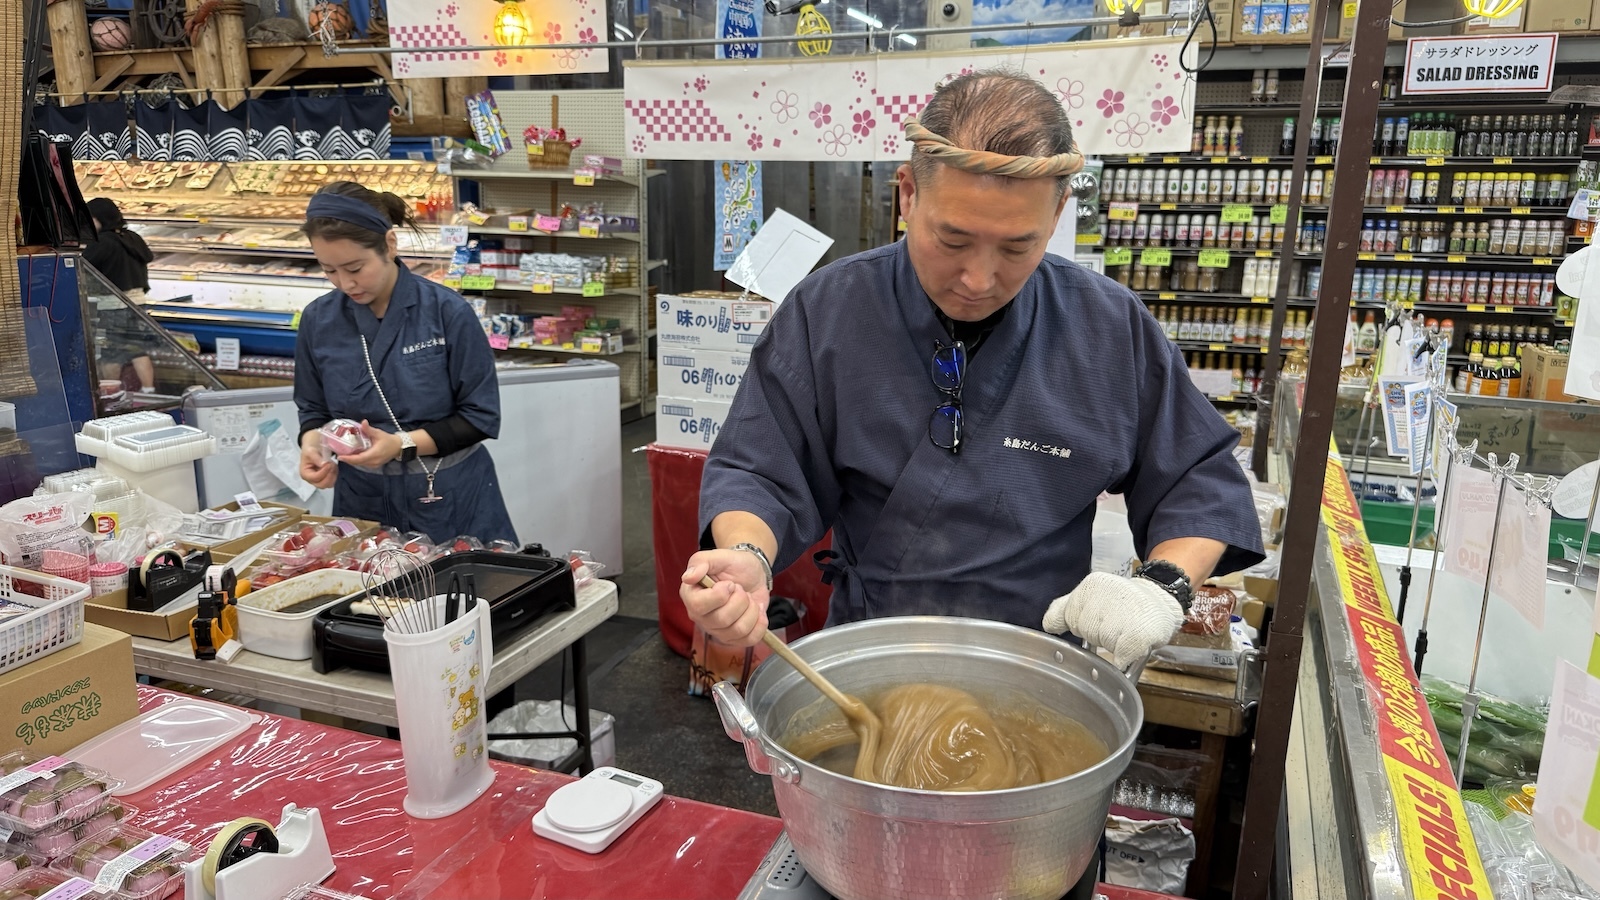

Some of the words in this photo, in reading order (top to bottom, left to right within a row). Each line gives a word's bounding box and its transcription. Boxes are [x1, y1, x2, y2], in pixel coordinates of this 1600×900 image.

[1425, 44, 1539, 59] サラダドレッシング
[1416, 67, 1462, 82] SALAD
[1465, 65, 1539, 81] DRESSING
[677, 309, 718, 329] 味のり
[681, 369, 700, 384] 90
[714, 372, 742, 386] のり
[680, 419, 698, 434] 90
[1346, 560, 1386, 618] WEEKLY
[1195, 593, 1229, 604] BROWN
[1360, 616, 1441, 769] 今週のお勧め商品!
[16, 692, 102, 745] 抹茶もち
[1403, 773, 1480, 900] ECIALS!
[1119, 850, 1138, 861] OFF
